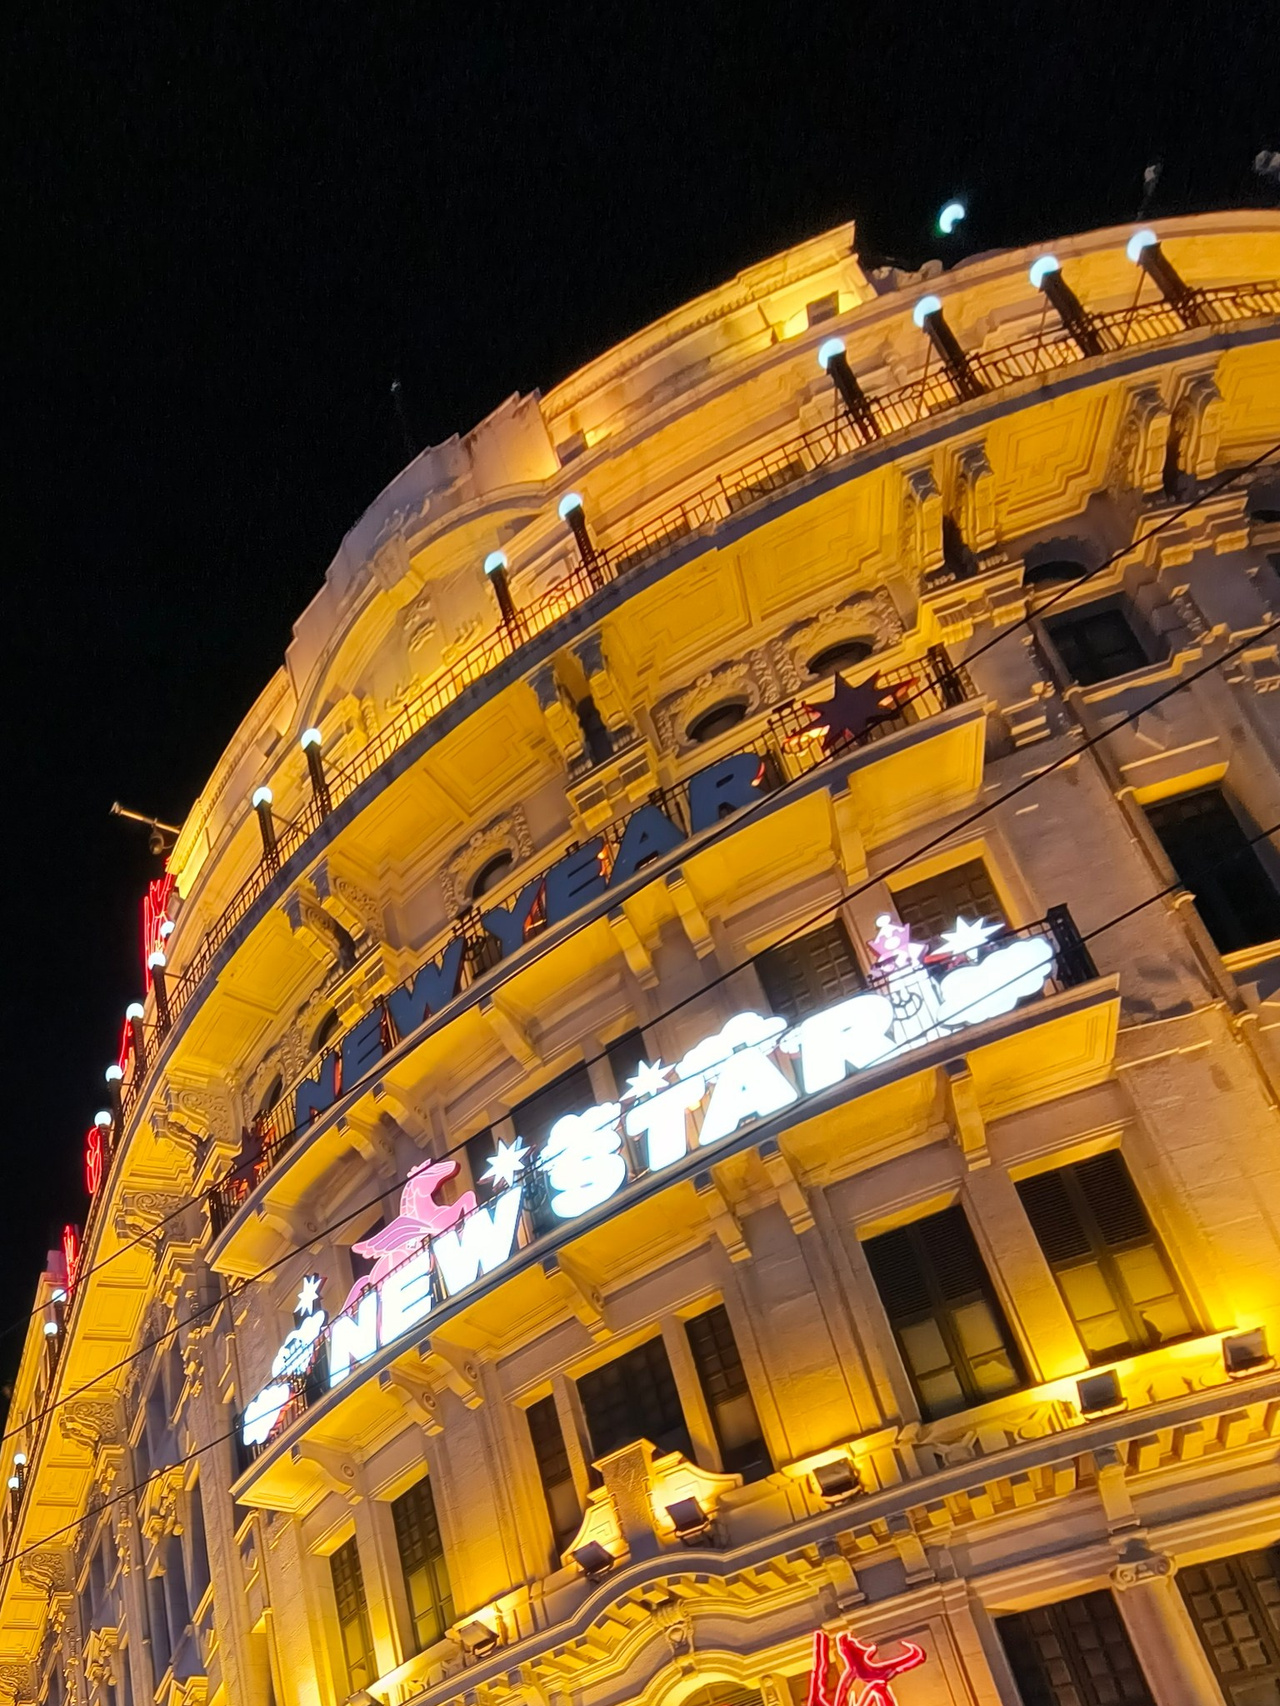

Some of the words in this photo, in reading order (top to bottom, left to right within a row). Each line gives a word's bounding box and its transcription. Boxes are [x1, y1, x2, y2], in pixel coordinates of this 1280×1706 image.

[295, 936, 465, 1139] NEW
[481, 752, 768, 957] YEAR
[329, 1185, 523, 1388] NEW
[549, 993, 897, 1218] STAR
